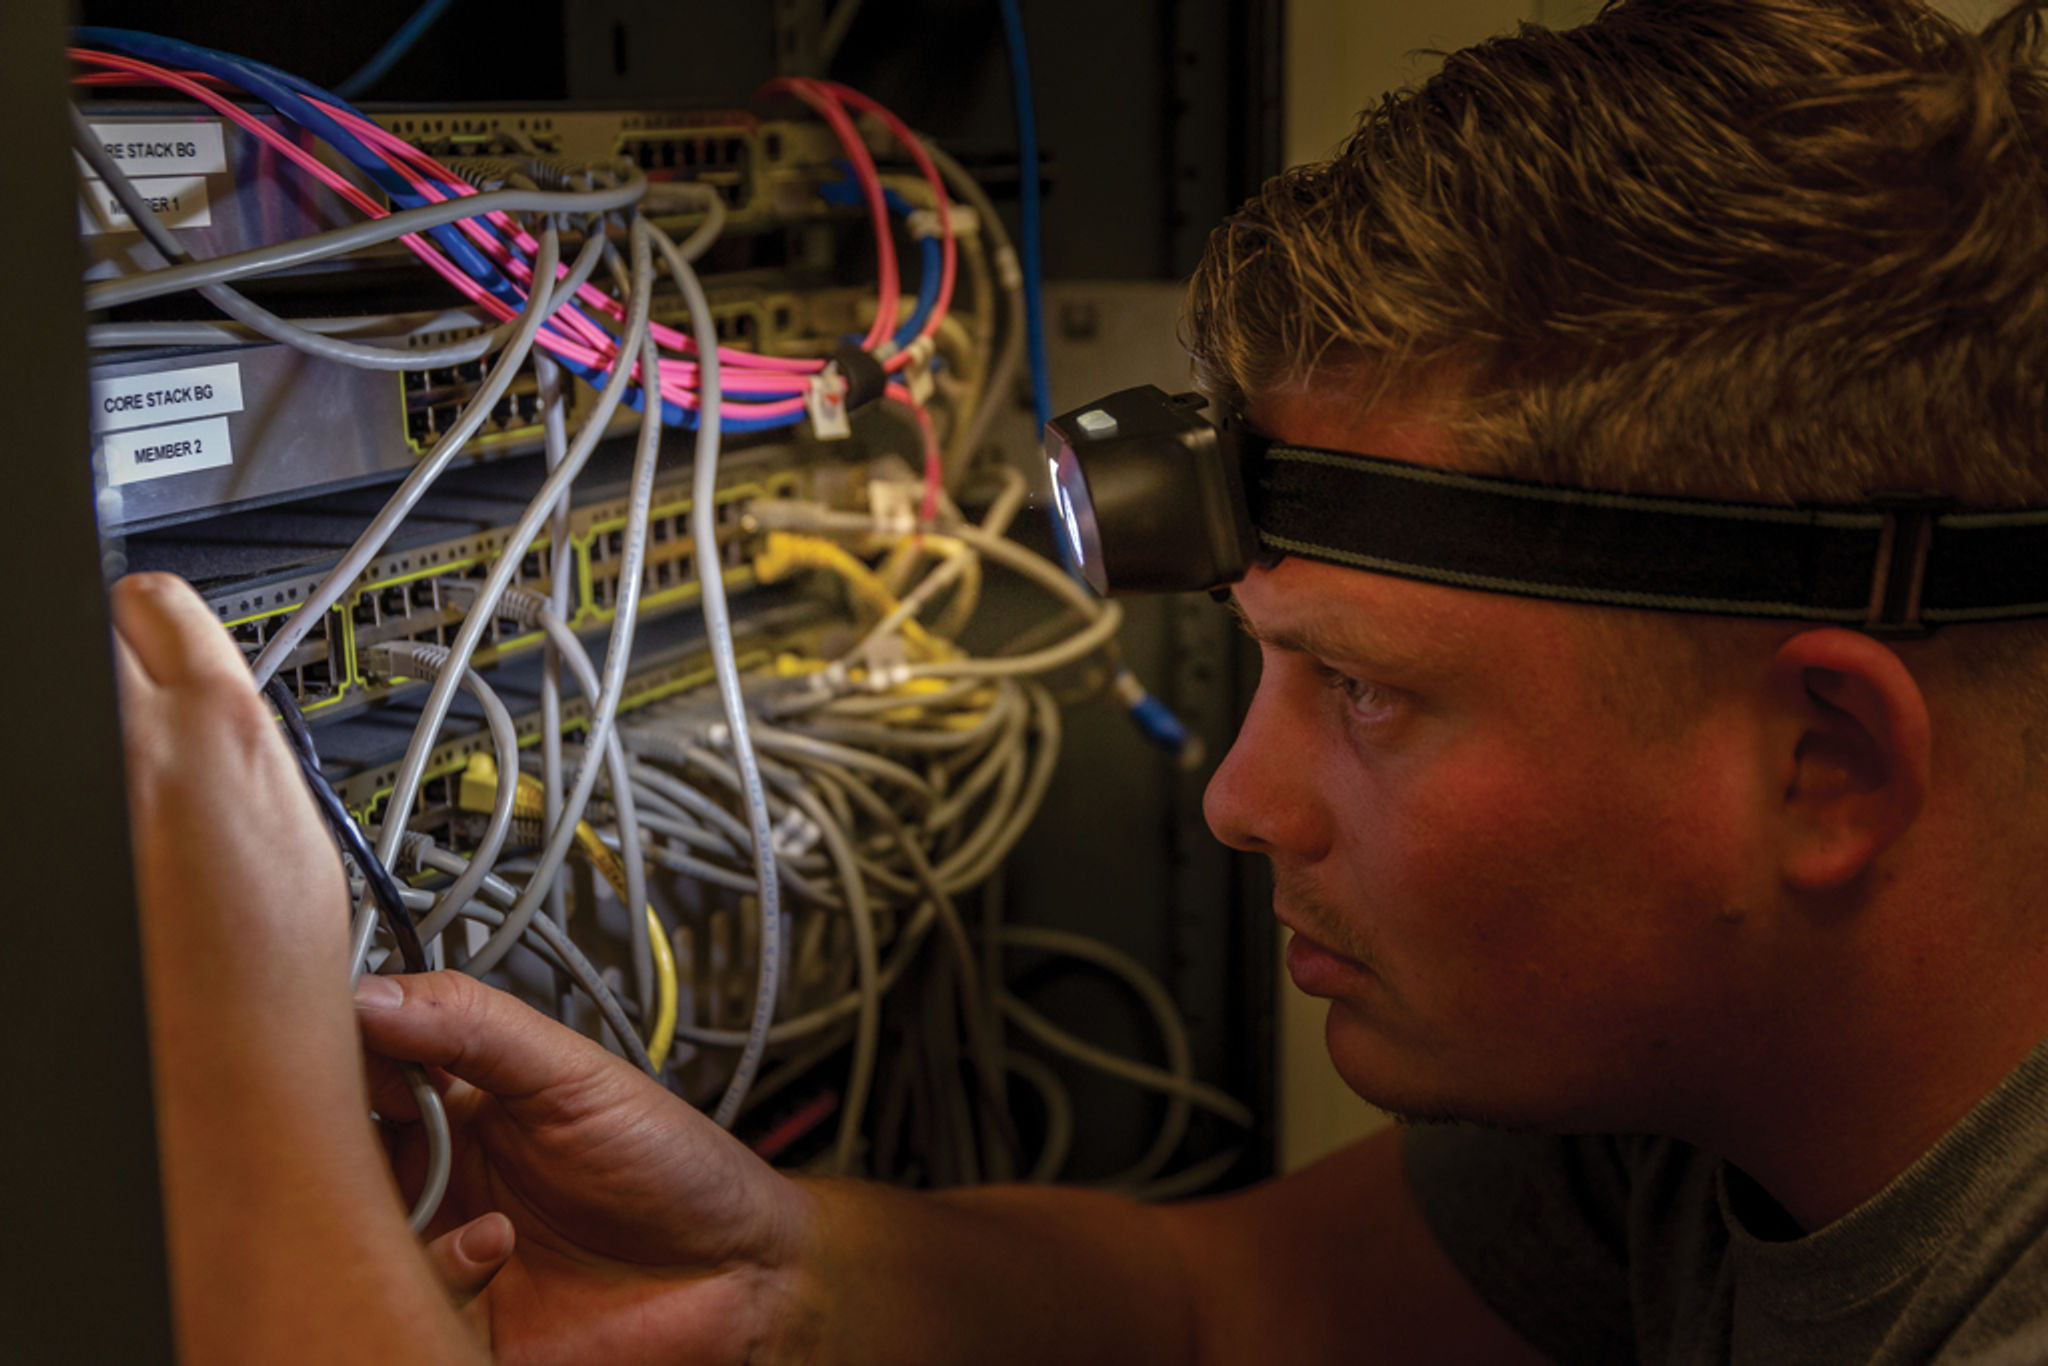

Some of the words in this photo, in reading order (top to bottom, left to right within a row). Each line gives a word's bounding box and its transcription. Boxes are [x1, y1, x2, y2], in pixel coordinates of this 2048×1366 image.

[127, 143, 174, 158] STACK
[176, 142, 196, 157] BG
[173, 196, 179, 211] 1
[104, 394, 143, 413] CORE
[146, 387, 191, 407] STACK
[194, 384, 213, 400] BG
[134, 441, 192, 464] MEMBER
[194, 439, 203, 454] 2
